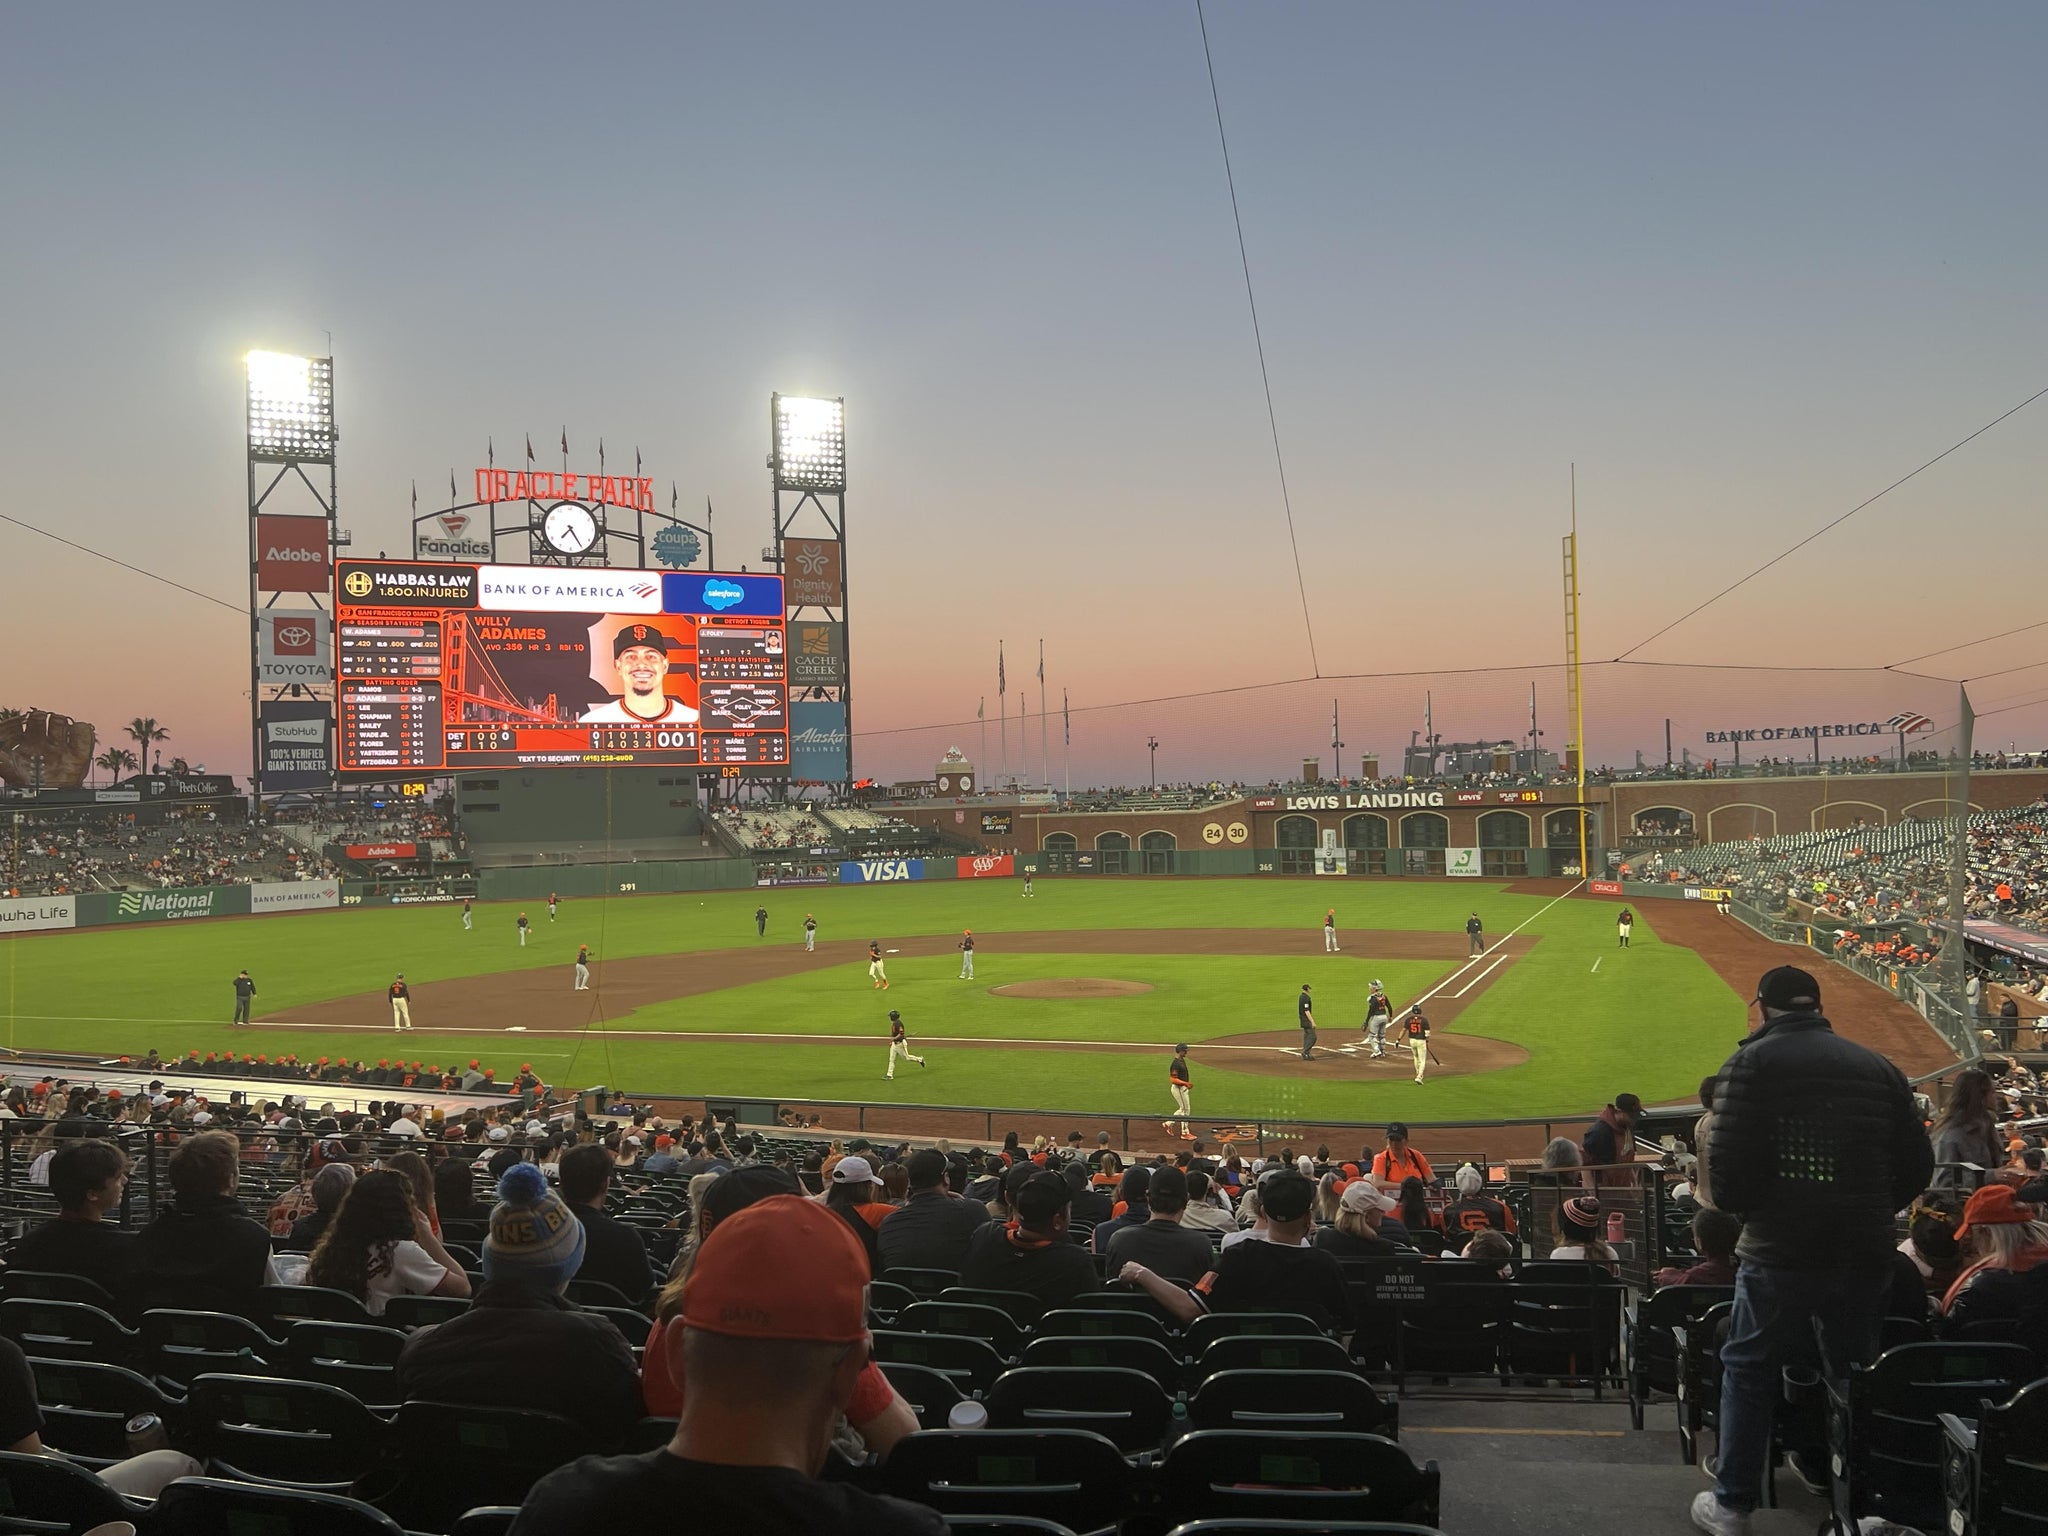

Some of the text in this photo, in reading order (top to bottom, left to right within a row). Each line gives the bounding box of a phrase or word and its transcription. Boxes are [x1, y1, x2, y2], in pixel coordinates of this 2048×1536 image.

[475, 468, 656, 513] ORACLE PARK
[659, 534, 696, 547] coupa
[419, 537, 490, 556] Fanatics
[266, 547, 322, 562] Adobe
[376, 573, 471, 587] HABBAS LAW
[793, 578, 832, 593] Dignity
[380, 587, 469, 598] 1.800.INJURED
[484, 584, 625, 598] BANK OF AMERICA
[708, 590, 741, 599] salesforce
[795, 592, 832, 604] Health
[373, 609, 412, 617] FRANCISCO
[474, 616, 511, 627] WILLY
[480, 628, 547, 641] ADAMES
[795, 656, 837, 666] CACHE
[264, 664, 327, 675] TOYOTA
[797, 665, 836, 675] CREEK
[275, 727, 317, 737] StubHub
[477, 732, 484, 740] 0
[490, 732, 497, 740] 0
[502, 732, 509, 740] 0
[592, 732, 600, 740] 0
[792, 727, 846, 744] Alaska
[1706, 722, 1881, 743] BANK OF AMERICA
[451, 742, 462, 750] SF
[594, 741, 599, 749] 1
[607, 741, 614, 749] 4
[620, 741, 627, 749] 0
[633, 741, 639, 749] 3
[645, 741, 651, 749] 4
[270, 748, 324, 760] 100% VERIFIED
[268, 760, 326, 771] GIANTS TICKETS
[722, 767, 740, 777] 0:29
[180, 782, 218, 793] Peet's Coffee
[403, 784, 425, 796] 0:29
[1346, 792, 1444, 809] LANDING
[1522, 792, 1537, 801] 105
[992, 816, 1011, 825] Sports
[1207, 829, 1221, 838] 24
[1231, 828, 1244, 838] 30
[368, 848, 396, 856] Adobe
[973, 858, 993, 871] AAA
[857, 862, 909, 880] VISA
[1563, 867, 1580, 875] 309
[620, 883, 636, 892] 391
[1594, 884, 1618, 892] ORACLE
[142, 891, 214, 911] National
[287, 893, 321, 901] AMERICA
[343, 896, 361, 904] 399
[426, 894, 454, 902] MINOLTA
[40, 907, 68, 919] Life
[167, 909, 210, 919] Car Rental
[1410, 1023, 1420, 1033] 51
[1385, 1275, 1414, 1284] DO NOT
[720, 1307, 771, 1327] GIANTS
